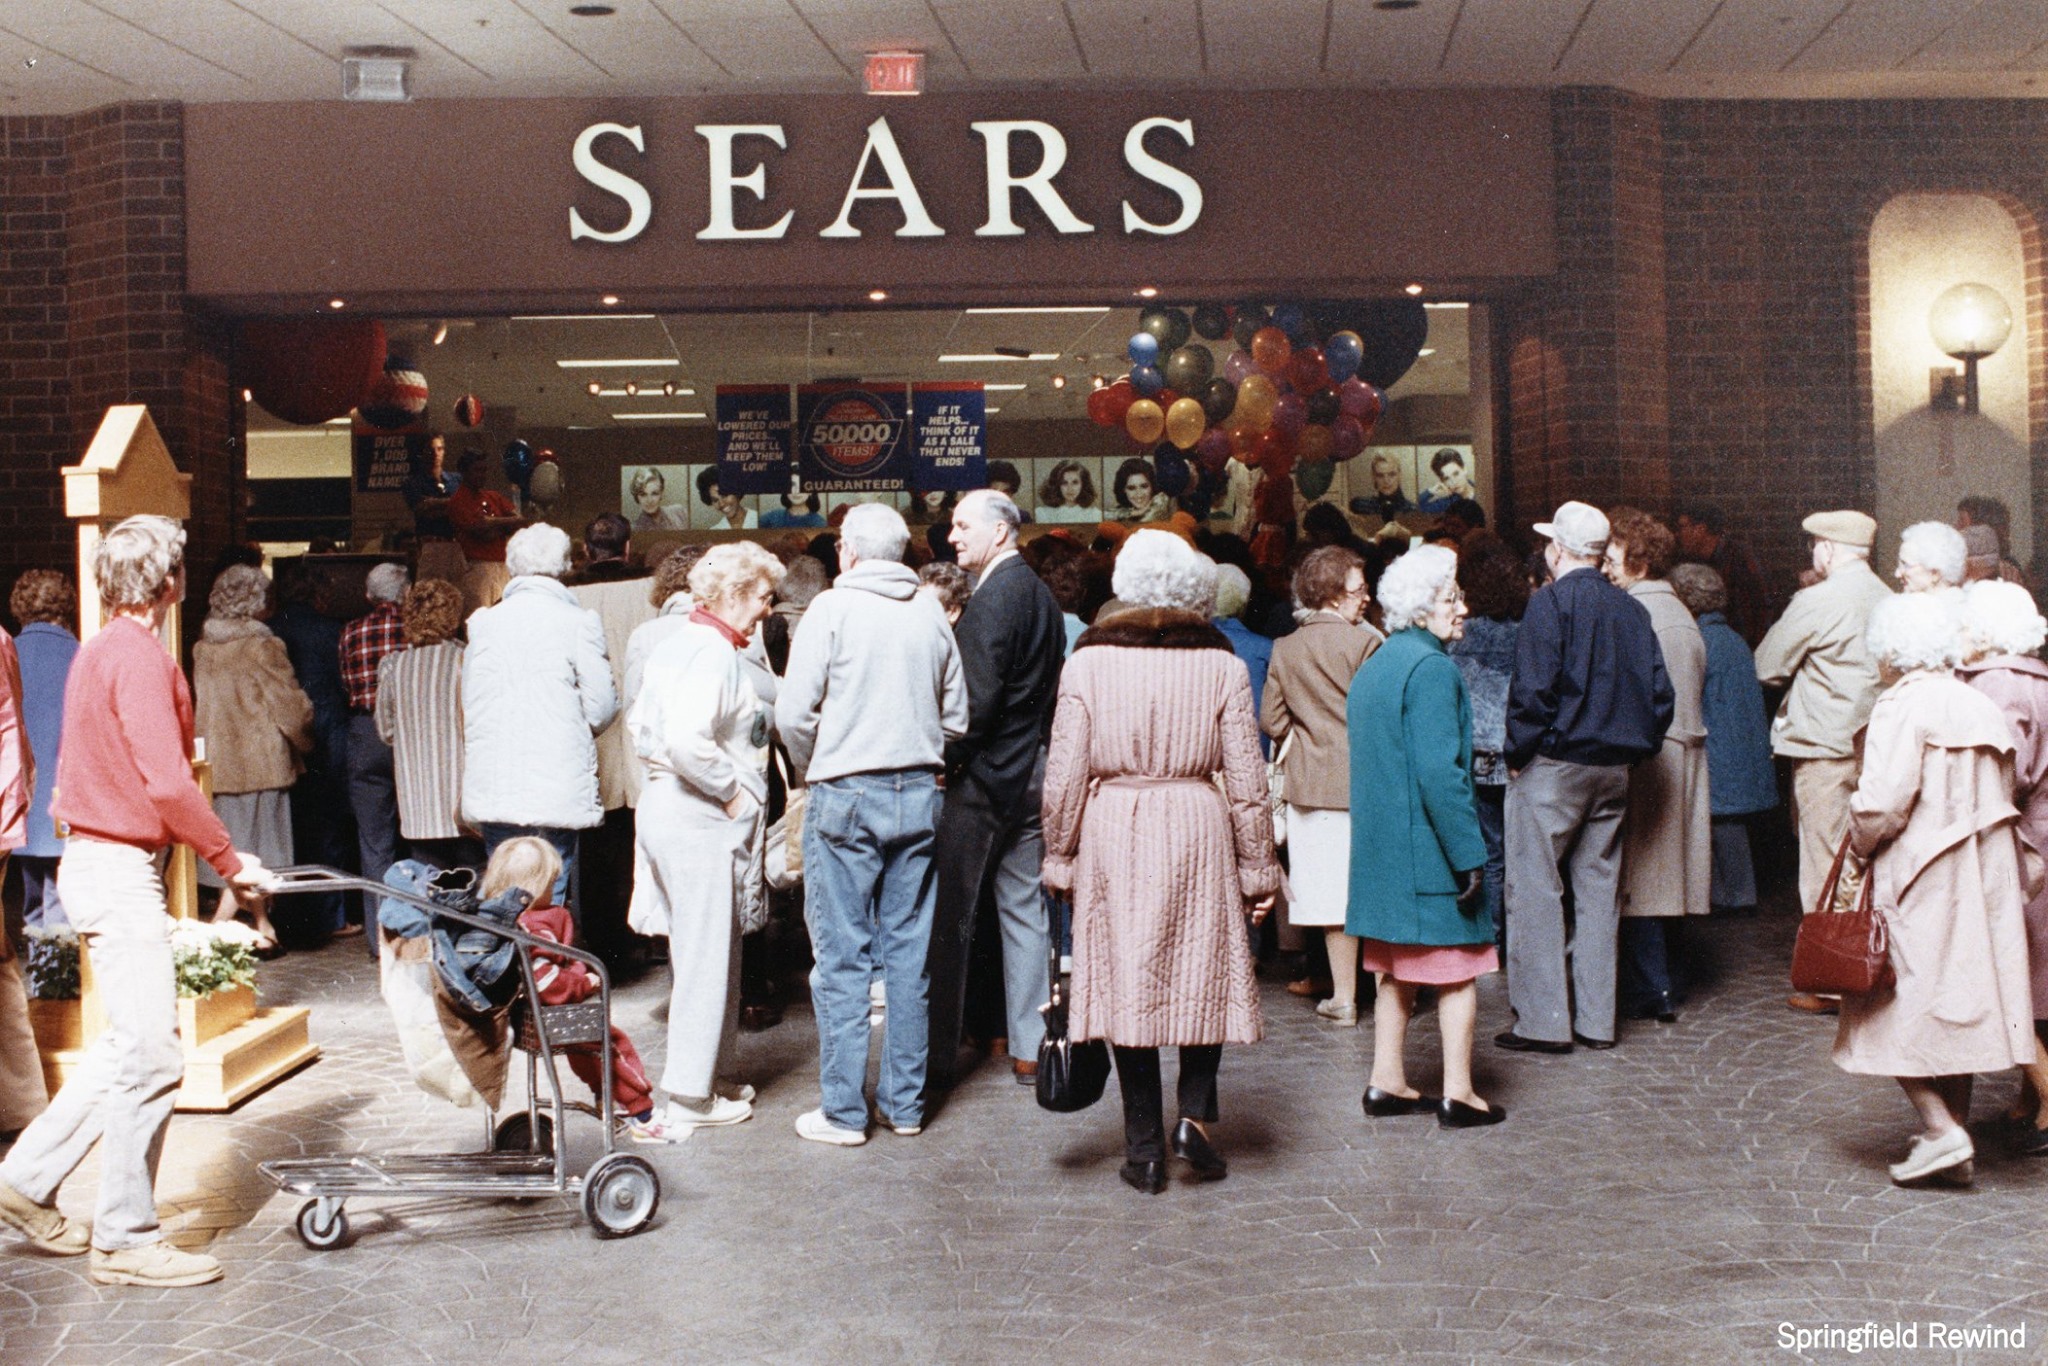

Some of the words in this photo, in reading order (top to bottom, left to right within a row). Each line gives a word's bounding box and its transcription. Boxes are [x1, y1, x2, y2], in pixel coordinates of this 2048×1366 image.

[569, 115, 1203, 243] SEARS
[938, 405, 949, 415] IF
[950, 405, 961, 415] IT
[718, 421, 766, 431] LOWERED
[768, 421, 790, 430] OUR
[920, 426, 951, 436] THINK
[953, 426, 968, 436] OF
[969, 425, 980, 435] IT
[375, 436, 405, 447] OVER
[924, 437, 938, 446] AS
[940, 437, 947, 446] A
[950, 436, 975, 446] SALE
[728, 442, 750, 451] AND
[832, 446, 874, 457] ITEMS!
[920, 447, 946, 456] THAT
[947, 446, 981, 456] NEVER
[725, 452, 753, 462] KEEP
[755, 452, 783, 461] THEM
[935, 457, 966, 467] ENDS!
[370, 463, 409, 475] BRAND
[742, 463, 768, 472] LOW!
[804, 479, 904, 490] GUARANTEED!
